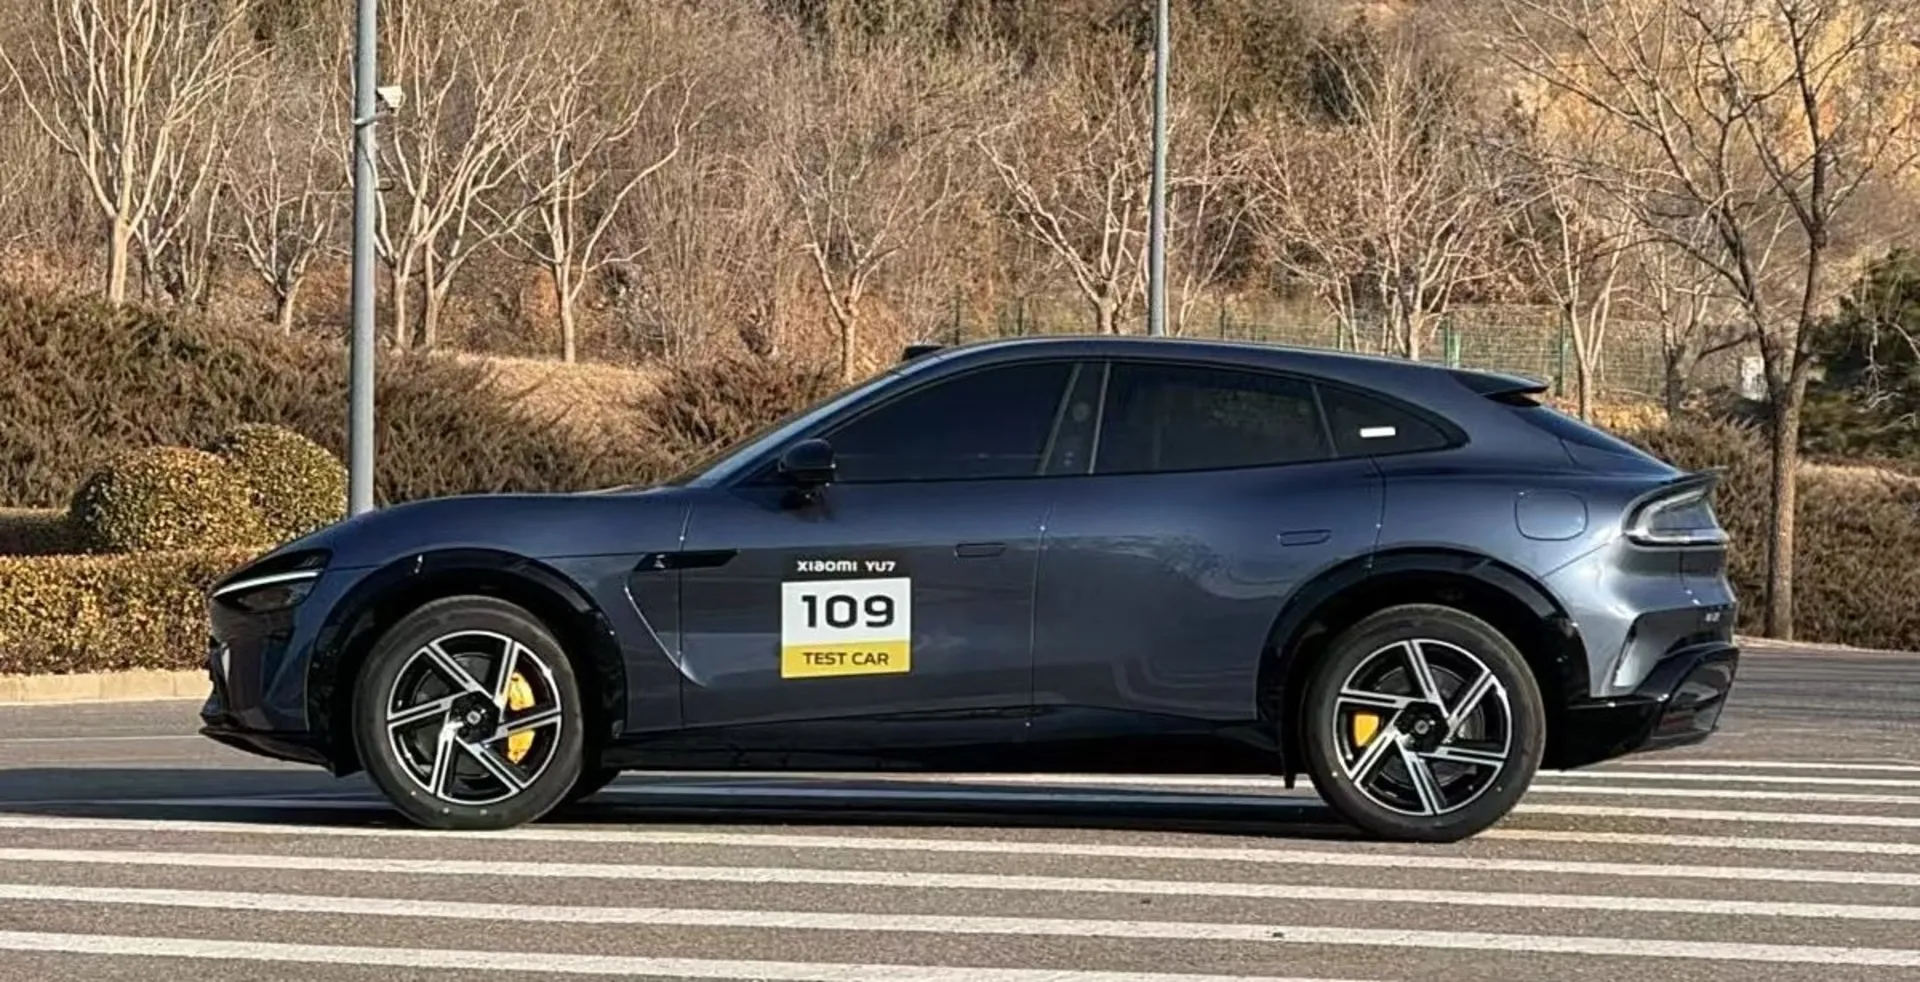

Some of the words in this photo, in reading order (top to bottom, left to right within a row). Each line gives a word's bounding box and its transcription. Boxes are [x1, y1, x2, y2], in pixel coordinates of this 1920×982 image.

[865, 560, 896, 572] YU7
[801, 594, 895, 629] 109
[803, 652, 847, 666] TEST
[851, 652, 889, 666] CAR
